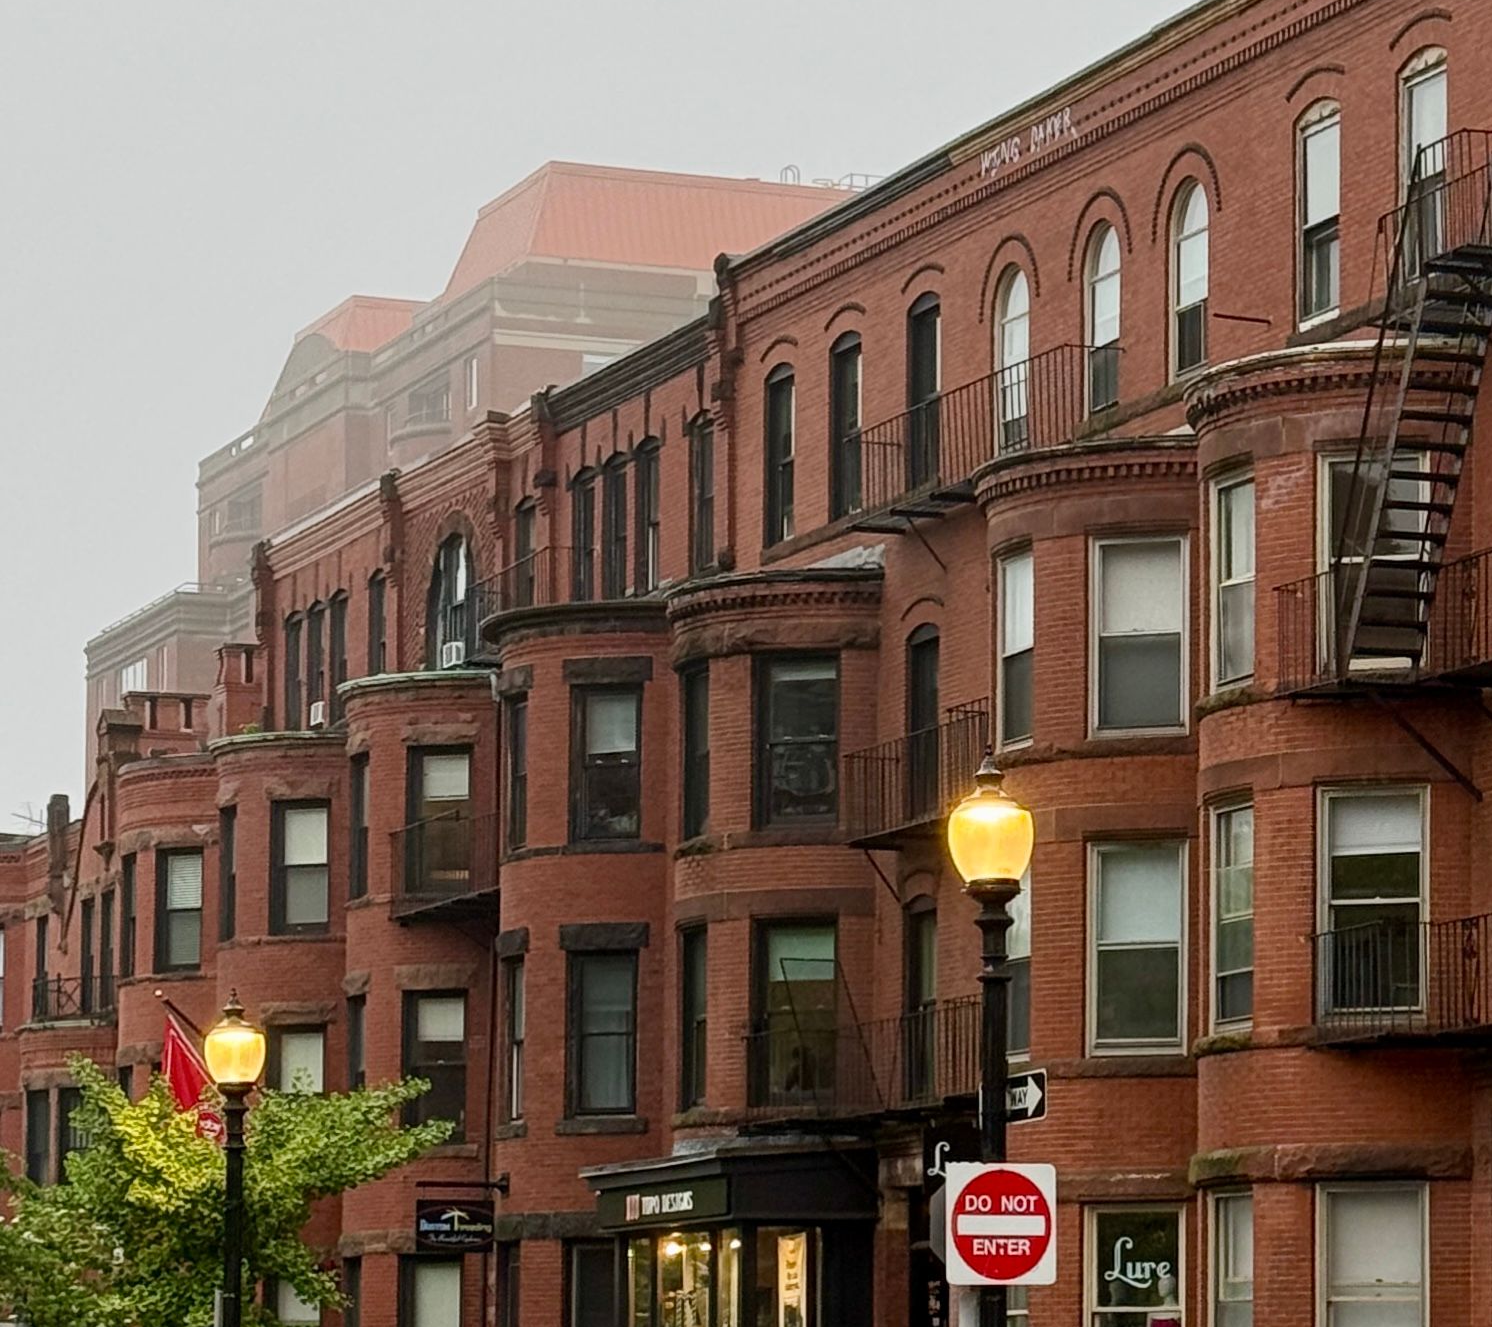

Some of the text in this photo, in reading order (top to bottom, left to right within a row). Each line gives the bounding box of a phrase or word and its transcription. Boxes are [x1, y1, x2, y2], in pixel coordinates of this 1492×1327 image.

[1010, 1089, 1028, 1108] WAY
[641, 1195, 660, 1215] TOPO
[965, 1195, 1039, 1211] DO NOT
[973, 1239, 1030, 1255] ENTER
[1104, 1236, 1171, 1288] Lure
